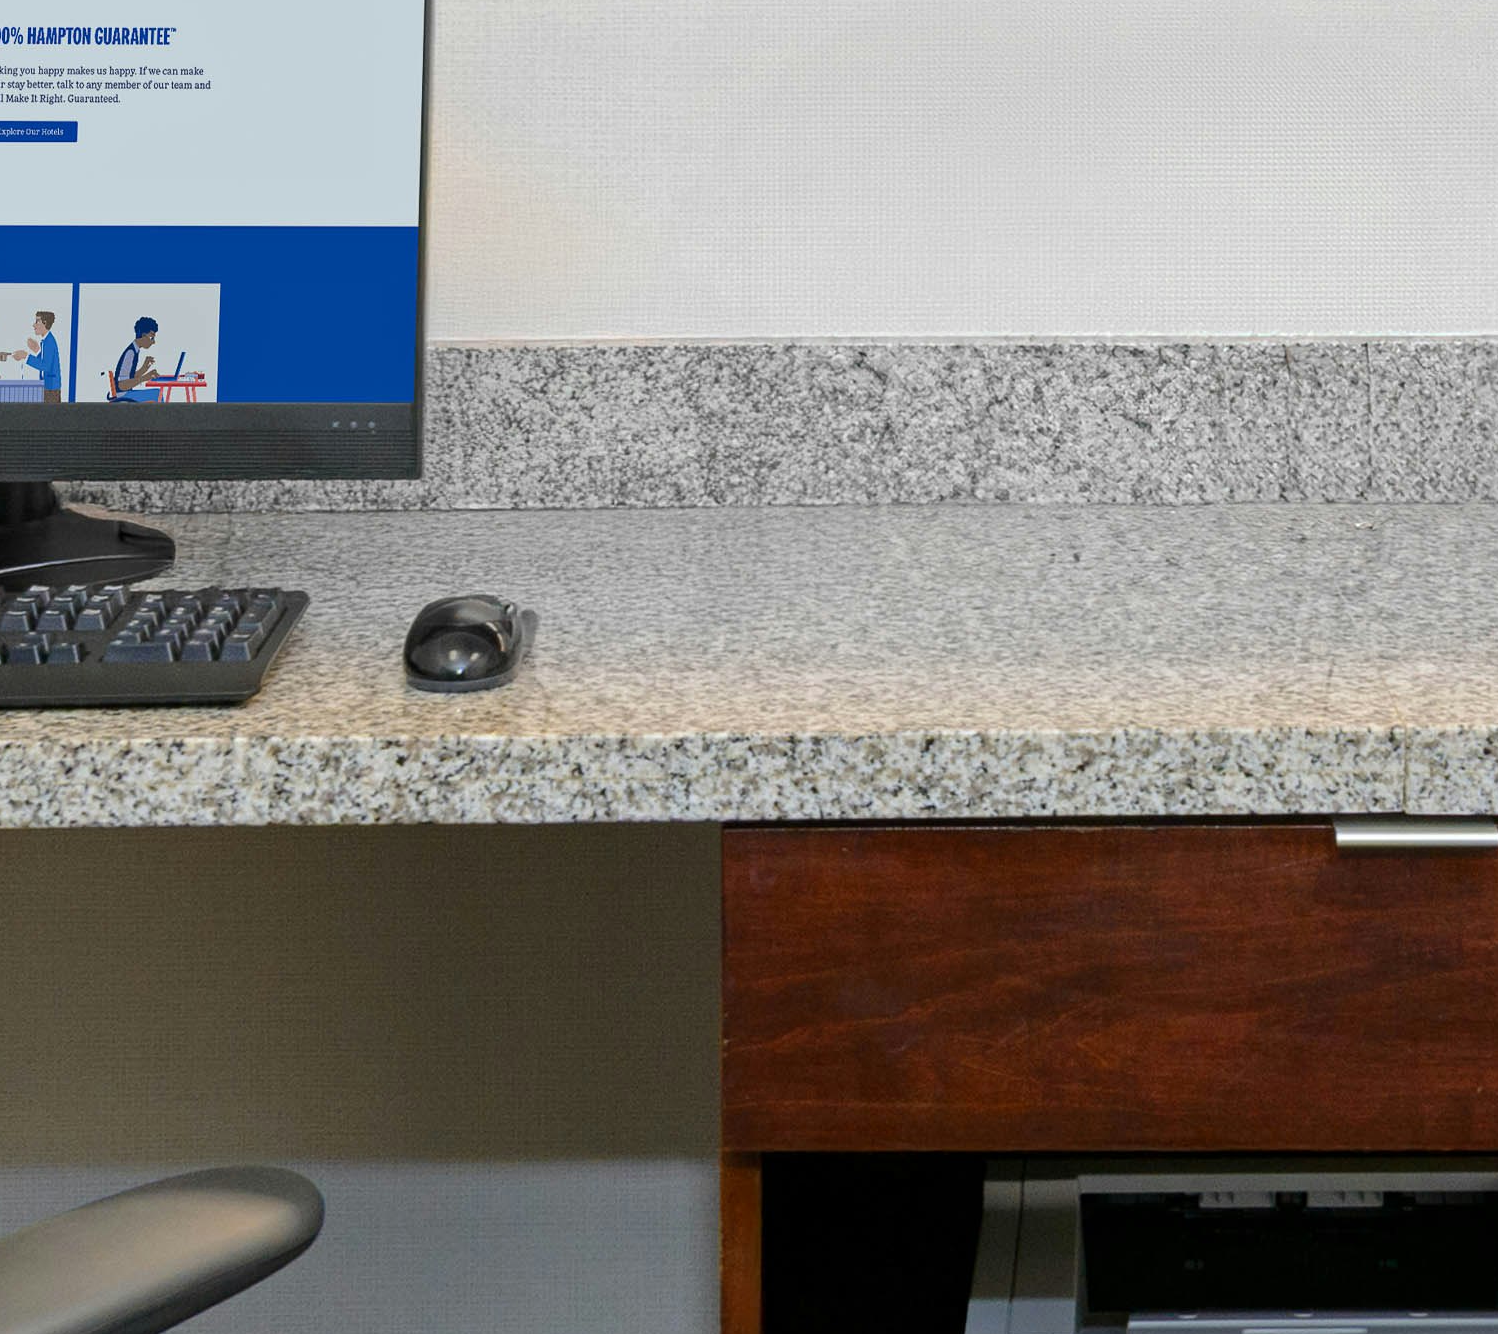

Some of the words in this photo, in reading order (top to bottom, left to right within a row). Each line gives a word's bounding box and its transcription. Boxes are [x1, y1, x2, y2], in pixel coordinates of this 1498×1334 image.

[27, 27, 91, 45] HAMPTON
[19, 67, 36, 77] you
[37, 65, 65, 78] happy
[66, 65, 95, 76] makes
[96, 67, 108, 76] us
[108, 65, 137, 78] happy.
[139, 65, 148, 76] If
[147, 67, 162, 76] we
[161, 68, 179, 76] can
[180, 66, 204, 76] make
[6, 80, 26, 91] stay
[26, 79, 55, 90] better,
[56, 79, 75, 90] talk
[75, 80, 85, 90] to
[85, 81, 103, 92] any
[104, 79, 142, 90] member
[142, 79, 153, 90] of
[153, 81, 170, 90] our
[170, 80, 193, 90] team
[194, 79, 212, 90] and
[5, 93, 30, 104] Make
[30, 93, 39, 103] It
[39, 93, 66, 106] Right.
[67, 93, 121, 104] Guaranteed.
[25, 128, 41, 136] Our
[41, 127, 64, 136] Hotels
